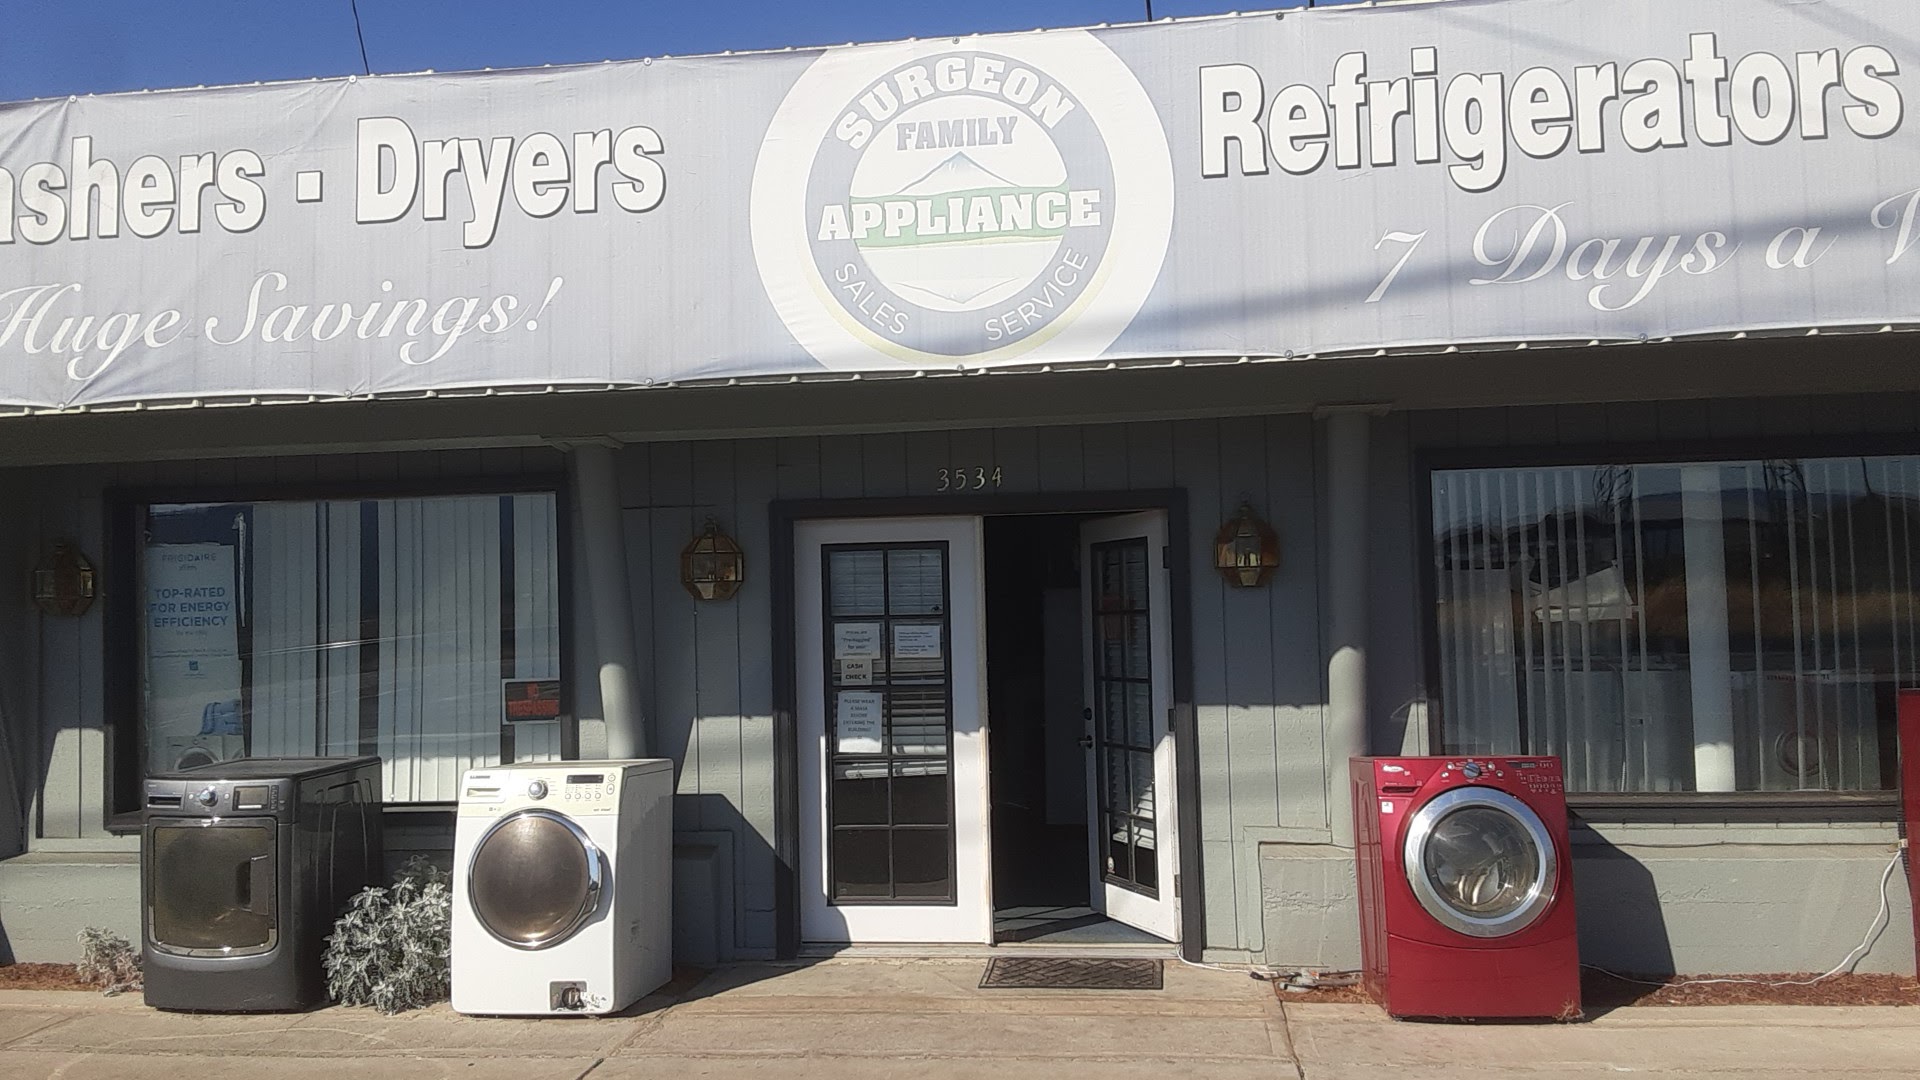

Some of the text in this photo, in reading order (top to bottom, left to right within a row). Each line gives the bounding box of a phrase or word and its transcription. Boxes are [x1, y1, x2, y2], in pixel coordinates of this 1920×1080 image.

[836, 56, 1076, 150] SURGEON
[896, 116, 1018, 151] FAMILY
[1199, 32, 1904, 192] Refrigerators
[356, 116, 666, 249] Dryers
[817, 189, 1102, 241] APPLIANCE
[1364, 228, 1428, 304] 7
[1469, 201, 1741, 312] Days
[1764, 226, 1838, 269] a
[835, 262, 910, 336] SALES
[984, 247, 1088, 342] SERVICE
[0, 271, 564, 382] Huge Savings!
[936, 466, 1003, 492] 3534
[161, 552, 217, 562] FRIGIDAIRE
[150, 601, 231, 614] FOR ENERGY
[153, 615, 229, 628] EFFICIENCY
[154, 586, 226, 599] TOP-RATED
